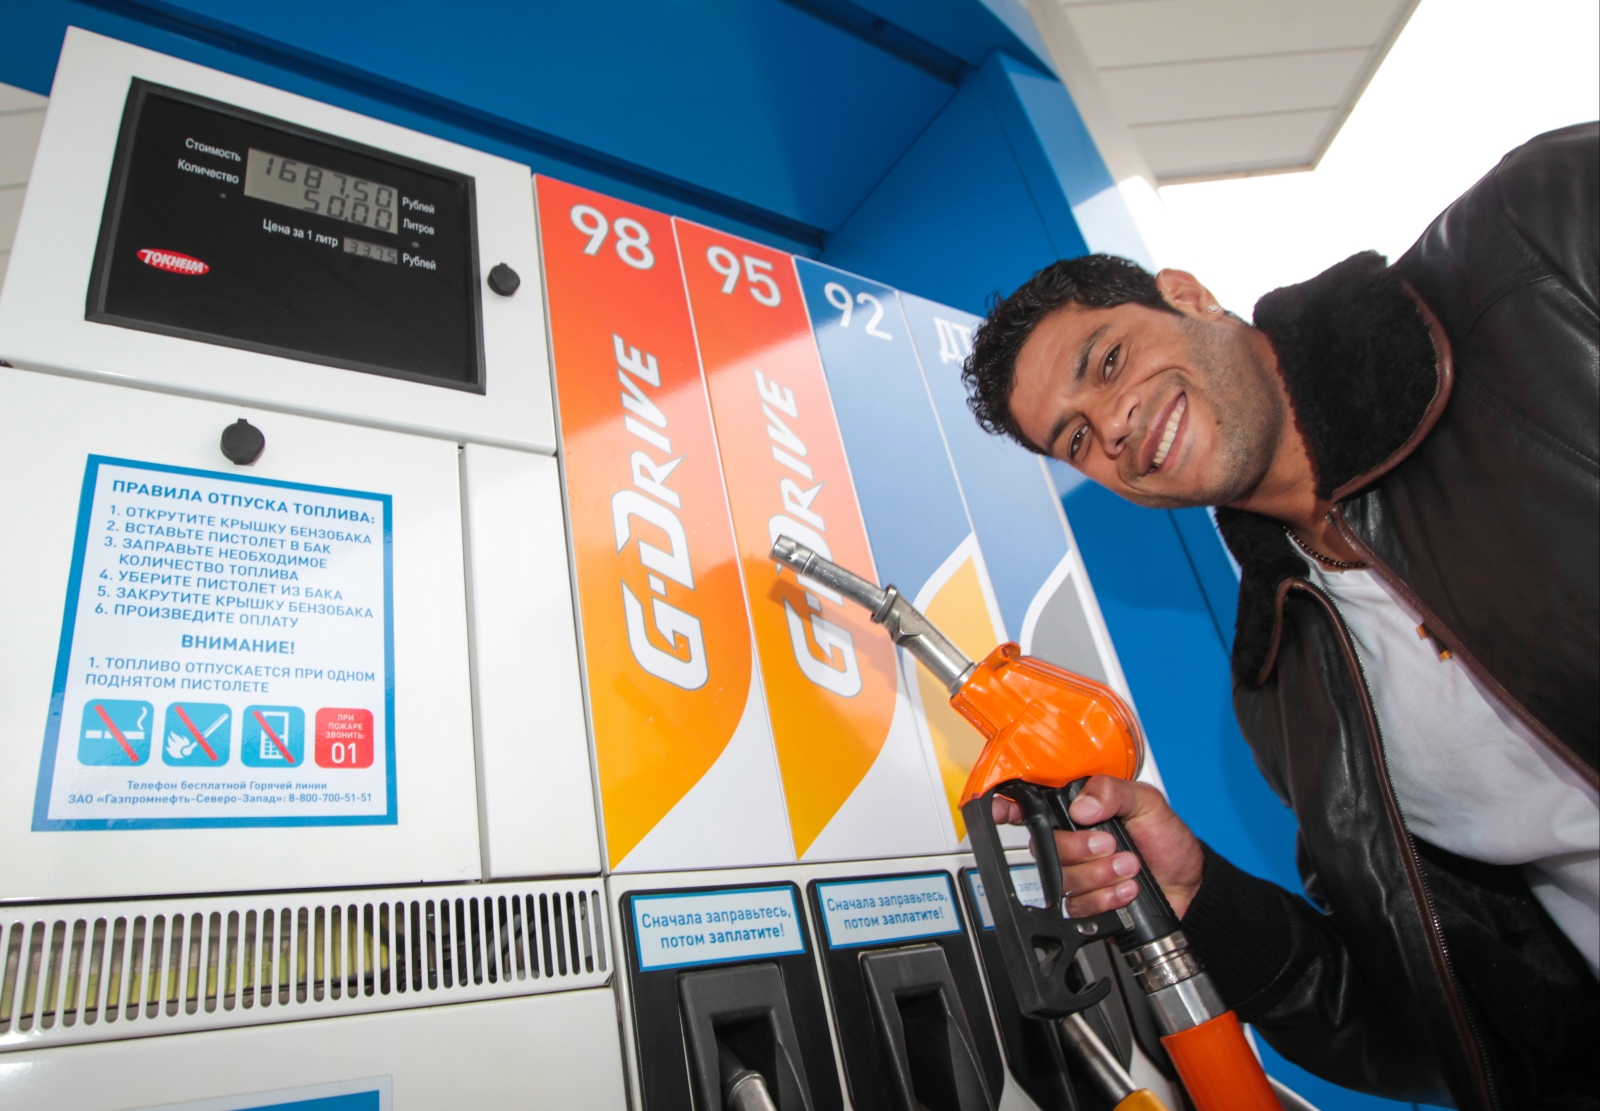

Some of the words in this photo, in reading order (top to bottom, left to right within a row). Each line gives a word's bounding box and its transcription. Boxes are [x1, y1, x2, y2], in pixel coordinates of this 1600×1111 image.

[185, 137, 242, 162] Стоимость
[177, 158, 239, 184] Количество
[265, 157, 393, 209] 1687.50
[303, 189, 393, 231] 50.00
[402, 196, 435, 215] Рублей
[263, 218, 291, 235] Цена
[292, 227, 304, 239] за
[307, 229, 313, 241] 1
[315, 233, 339, 248] литр
[403, 218, 435, 235] Литров
[568, 203, 656, 271] 98
[140, 249, 205, 273] TOKHEIM
[402, 252, 436, 271] Рублей
[705, 245, 782, 308] 95
[823, 281, 894, 342] 92
[112, 480, 203, 502] ПРАВИЛА
[207, 492, 288, 513] ОТПУСКА
[293, 503, 375, 524] ТОПЛИВА:
[106, 521, 119, 532] 2.
[124, 522, 204, 540] ВСТАВЬТЕ
[207, 532, 286, 549] ПИСТОЛЕТ
[290, 539, 299, 550] В
[303, 542, 331, 554] БАК
[109, 505, 121, 516] 1.
[125, 507, 216, 527] ОТКРУТИТЕ
[219, 517, 286, 535] КРЫШКУ
[290, 526, 372, 544] БЕНЗОБАКА
[103, 537, 117, 548] 3.
[121, 538, 214, 557] ЗАПРАВЬТЕ
[218, 548, 327, 569] НЕОБХОДИМОЕ
[118, 554, 224, 574] КОЛИЧЕСТВО
[228, 564, 299, 581] ТОПЛИВА
[98, 569, 113, 581] 4.
[118, 570, 192, 588] УБЕРИТЕ
[195, 577, 277, 594] ПИСТОЛЕТ
[280, 585, 300, 597] ИЗ
[304, 587, 342, 600] БАКА
[96, 586, 110, 598] 5.
[115, 587, 211, 605] ЗАКРУТИТЕ
[215, 595, 284, 611] КРЫШКУ
[288, 601, 373, 618] БЕНЗОБАКА
[94, 603, 107, 615] 6.
[113, 603, 235, 624] ПРОИЗВЕДИТЕ
[239, 613, 298, 628] ОПЛАТУ
[181, 635, 295, 654] ВНИМАНИЕ!
[84, 673, 176, 688] ПОДНЯТОМ
[180, 678, 269, 693] ПИСТОЛЕТЕ
[88, 657, 99, 668] 1.
[104, 657, 181, 672] ТОПЛИВО
[184, 662, 290, 678] ОТПУСКАЕТСЯ
[294, 668, 323, 679] ПРИ
[326, 670, 375, 683] ОДНОМ
[328, 722, 364, 731] ПОЖАРЕ
[337, 714, 355, 722] ПРИ
[331, 741, 358, 765] 01
[67, 793, 94, 804] ЗАО
[288, 793, 373, 803] 8-800-700-51-51
[127, 780, 178, 792] Телефон
[180, 780, 247, 792] бесплатной
[249, 780, 293, 792] Горячей
[294, 781, 328, 791] линии
[826, 897, 877, 913] Сначала
[878, 890, 948, 909] заправьтесь,
[641, 911, 703, 929] Сначала
[705, 905, 792, 926] заправьтесь,
[843, 916, 881, 931] потом
[882, 905, 945, 926] заплатите!
[660, 932, 706, 950] потом
[708, 922, 786, 945] заплатите!
